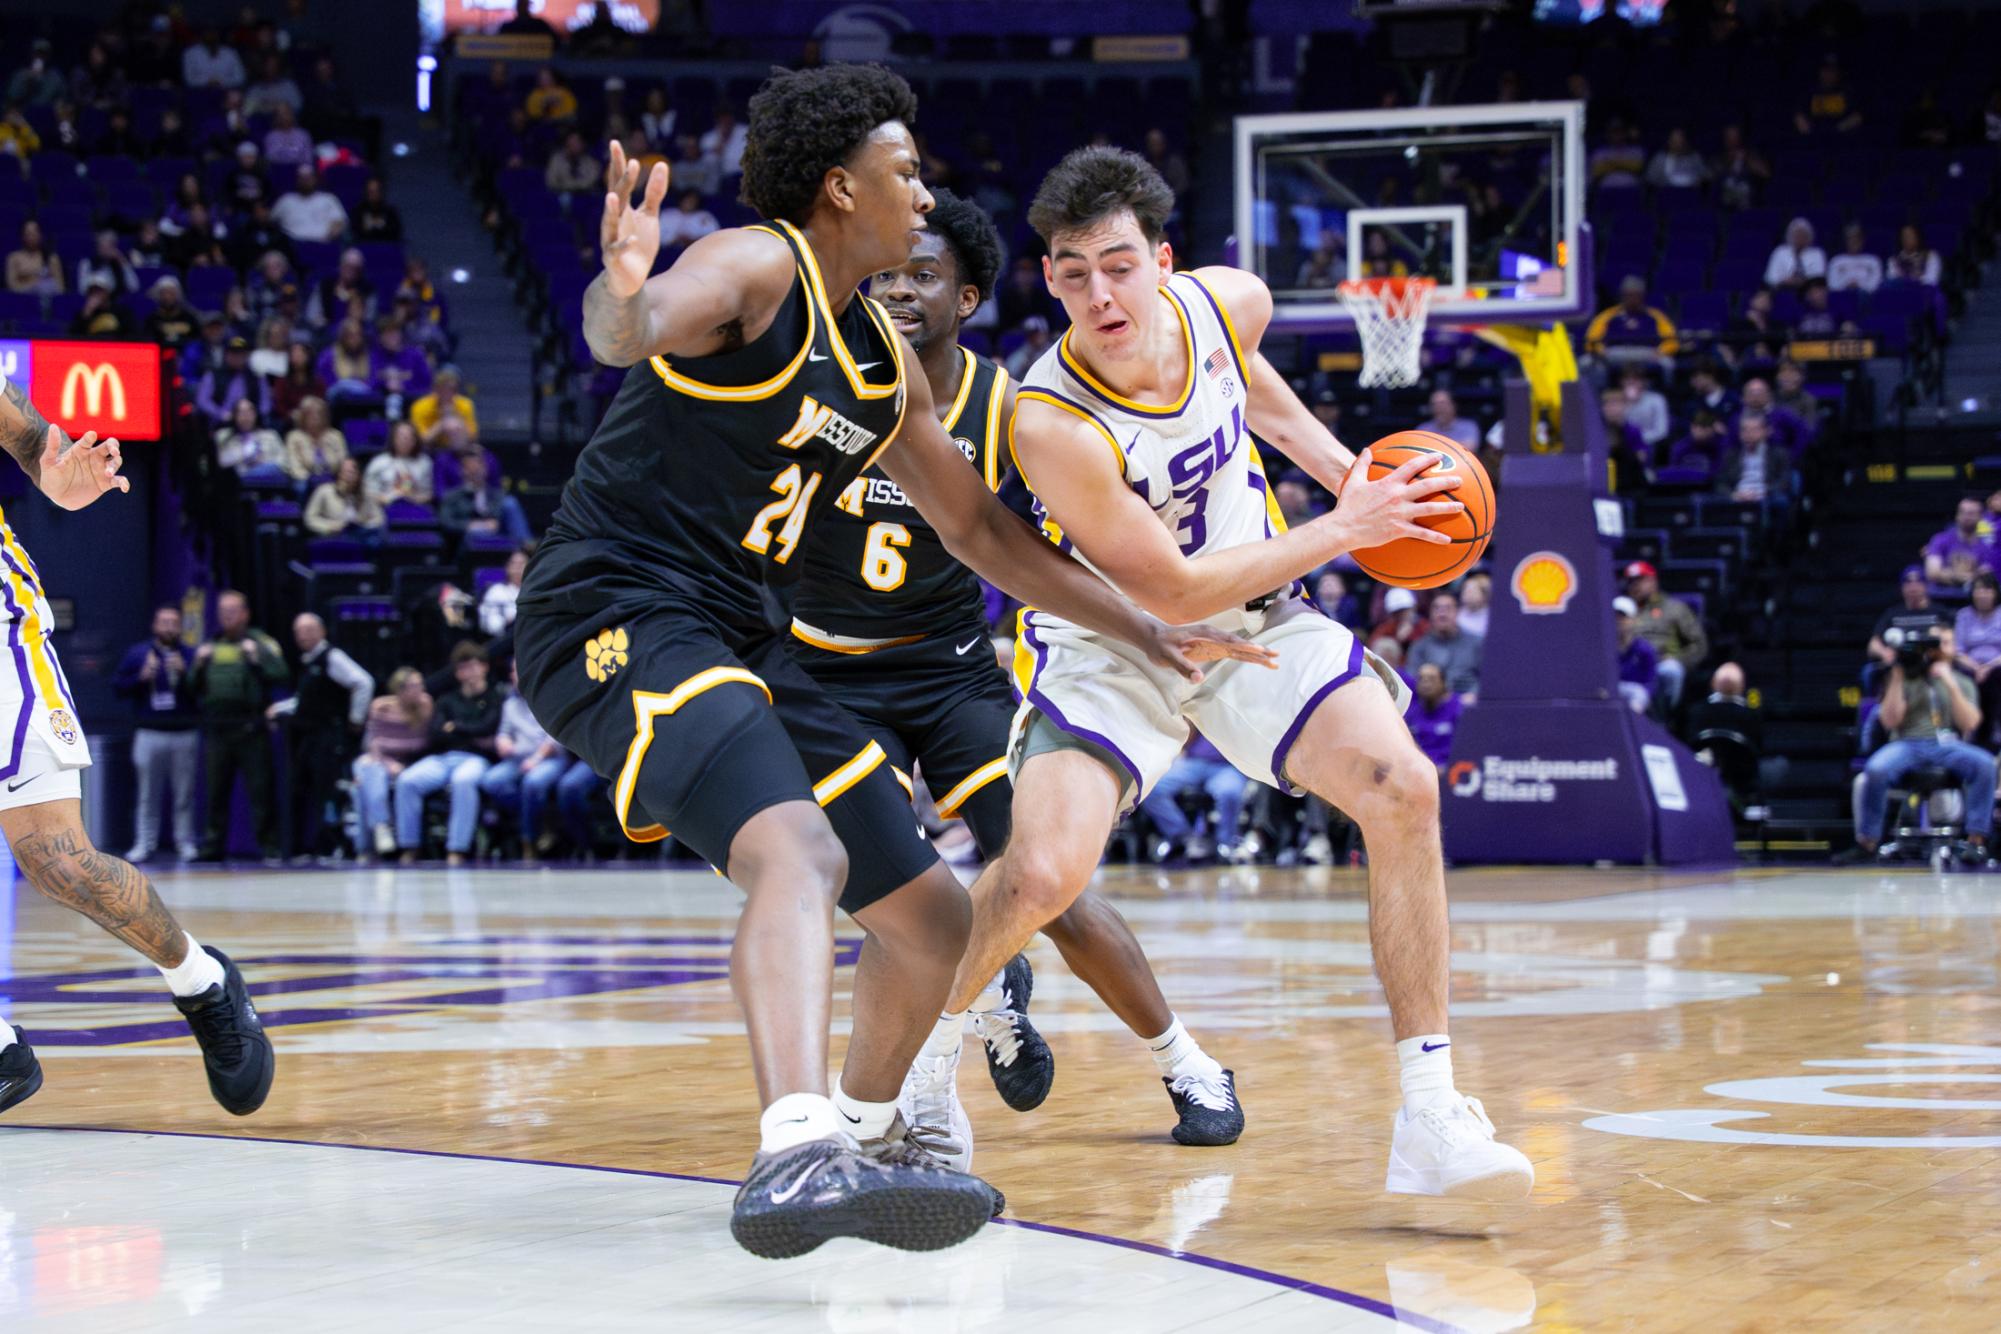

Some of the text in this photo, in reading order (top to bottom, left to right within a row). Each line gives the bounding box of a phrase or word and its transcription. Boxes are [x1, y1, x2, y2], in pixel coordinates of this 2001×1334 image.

[741, 463, 823, 565] 24
[834, 476, 915, 518] MISS
[1177, 486, 1209, 557] 3
[861, 521, 912, 592] 6
[1484, 755, 1618, 785] Equipment
[1484, 779, 1556, 802] Share
